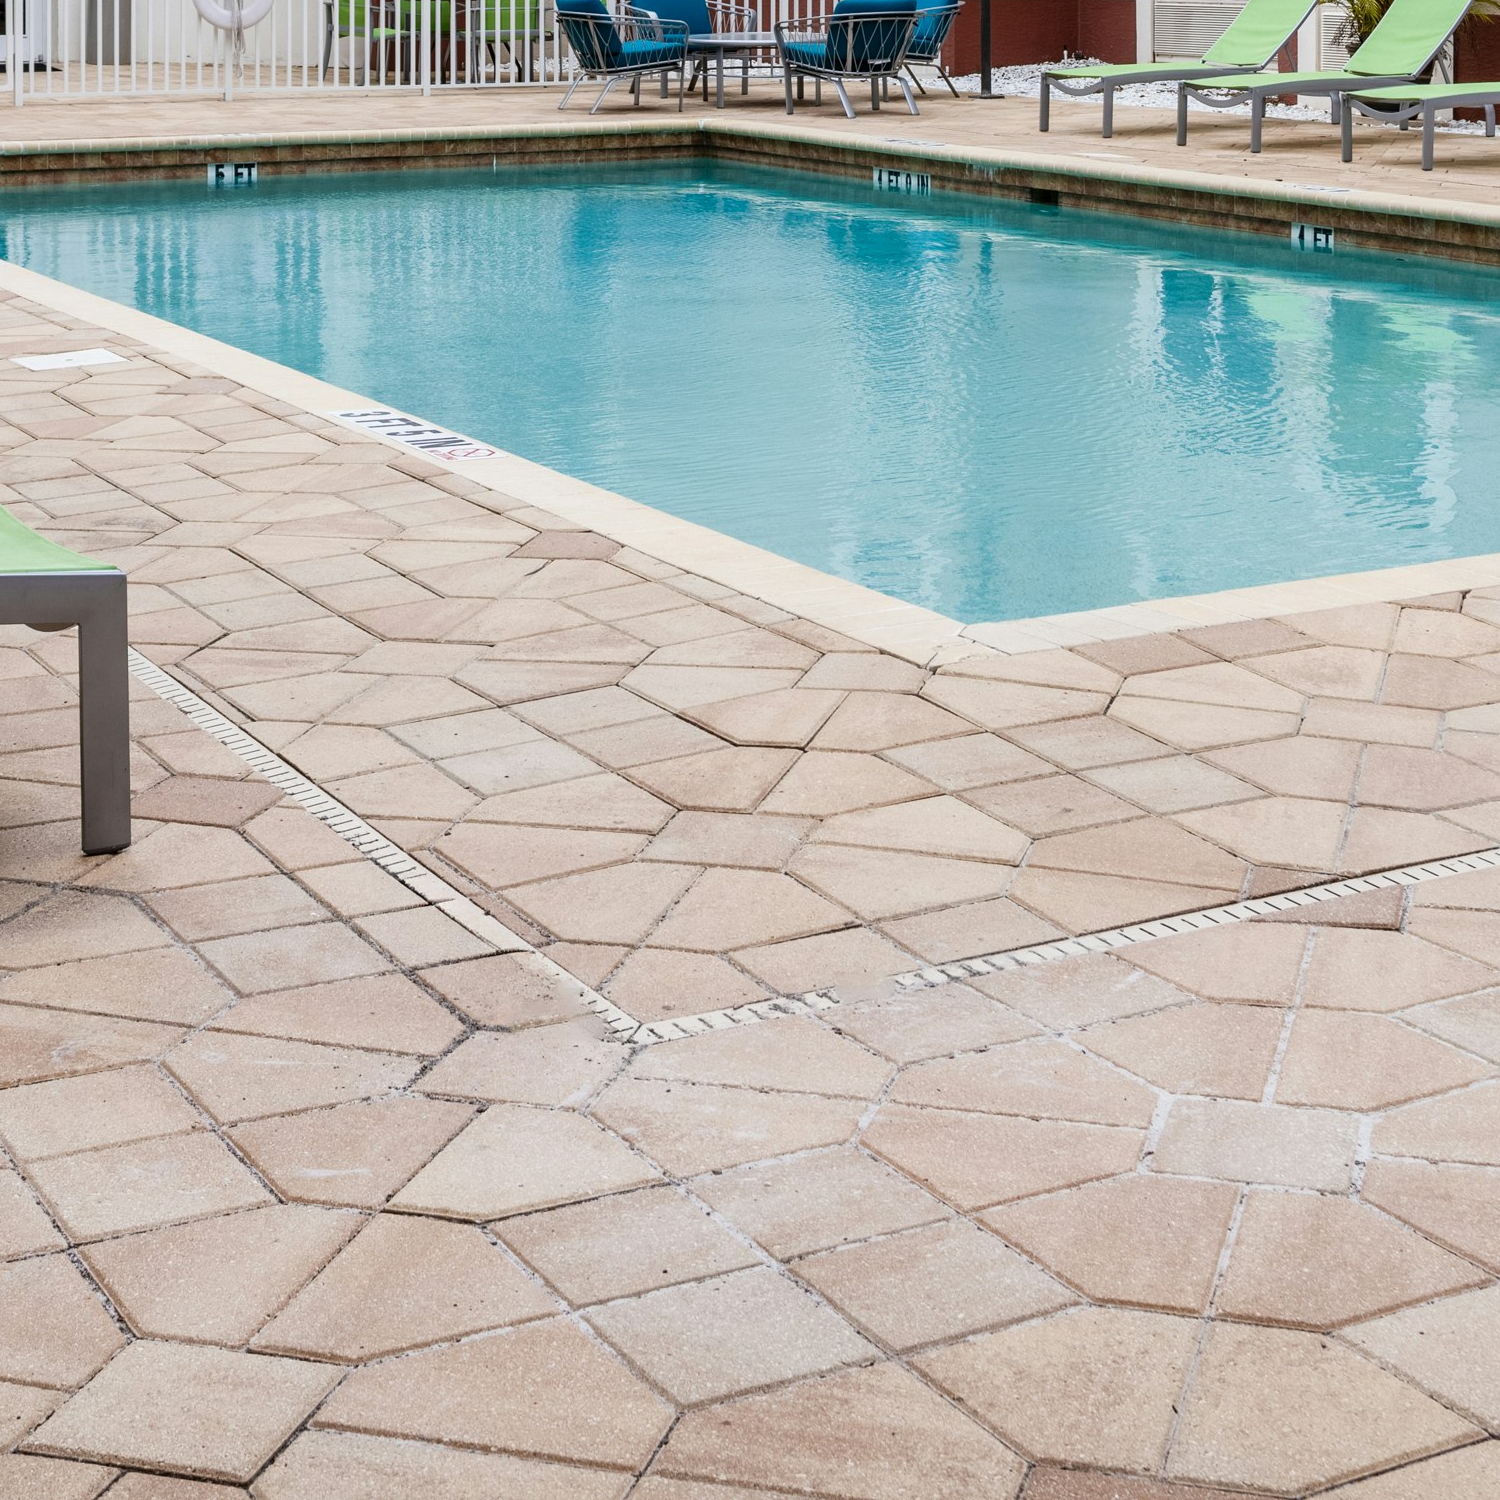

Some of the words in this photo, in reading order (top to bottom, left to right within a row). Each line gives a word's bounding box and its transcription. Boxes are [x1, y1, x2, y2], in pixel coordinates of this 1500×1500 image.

[234, 163, 255, 181] FT
[1314, 227, 1333, 244] FT
[354, 417, 424, 429] FT
[405, 429, 443, 437] 5
[404, 436, 474, 449] IN
